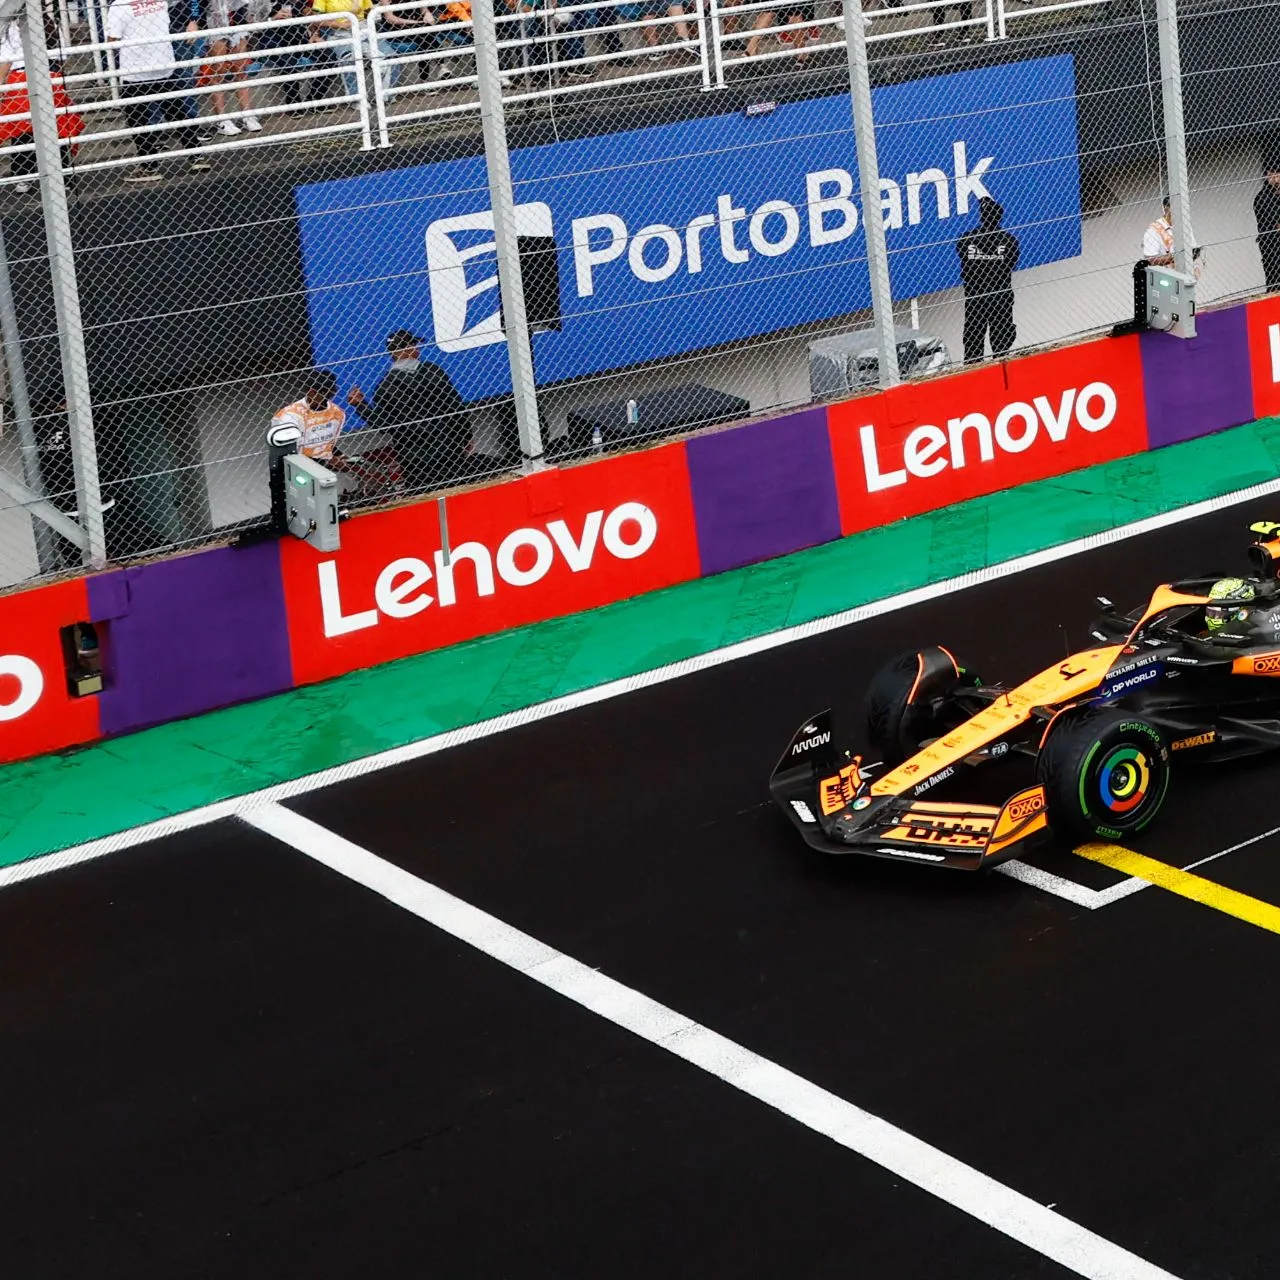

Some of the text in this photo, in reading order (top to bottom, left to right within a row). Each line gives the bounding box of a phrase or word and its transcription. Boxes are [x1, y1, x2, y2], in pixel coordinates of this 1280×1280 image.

[572, 140, 995, 297] PortoBank
[859, 380, 1117, 493] Lenovo
[317, 502, 658, 638] Lenovo
[1105, 655, 1158, 680] RICHARD MILLE
[1112, 669, 1157, 693] DP WORLD
[991, 744, 1009, 756] FIA
[914, 780, 930, 796] JACK
[1009, 797, 1043, 821] OXXO
